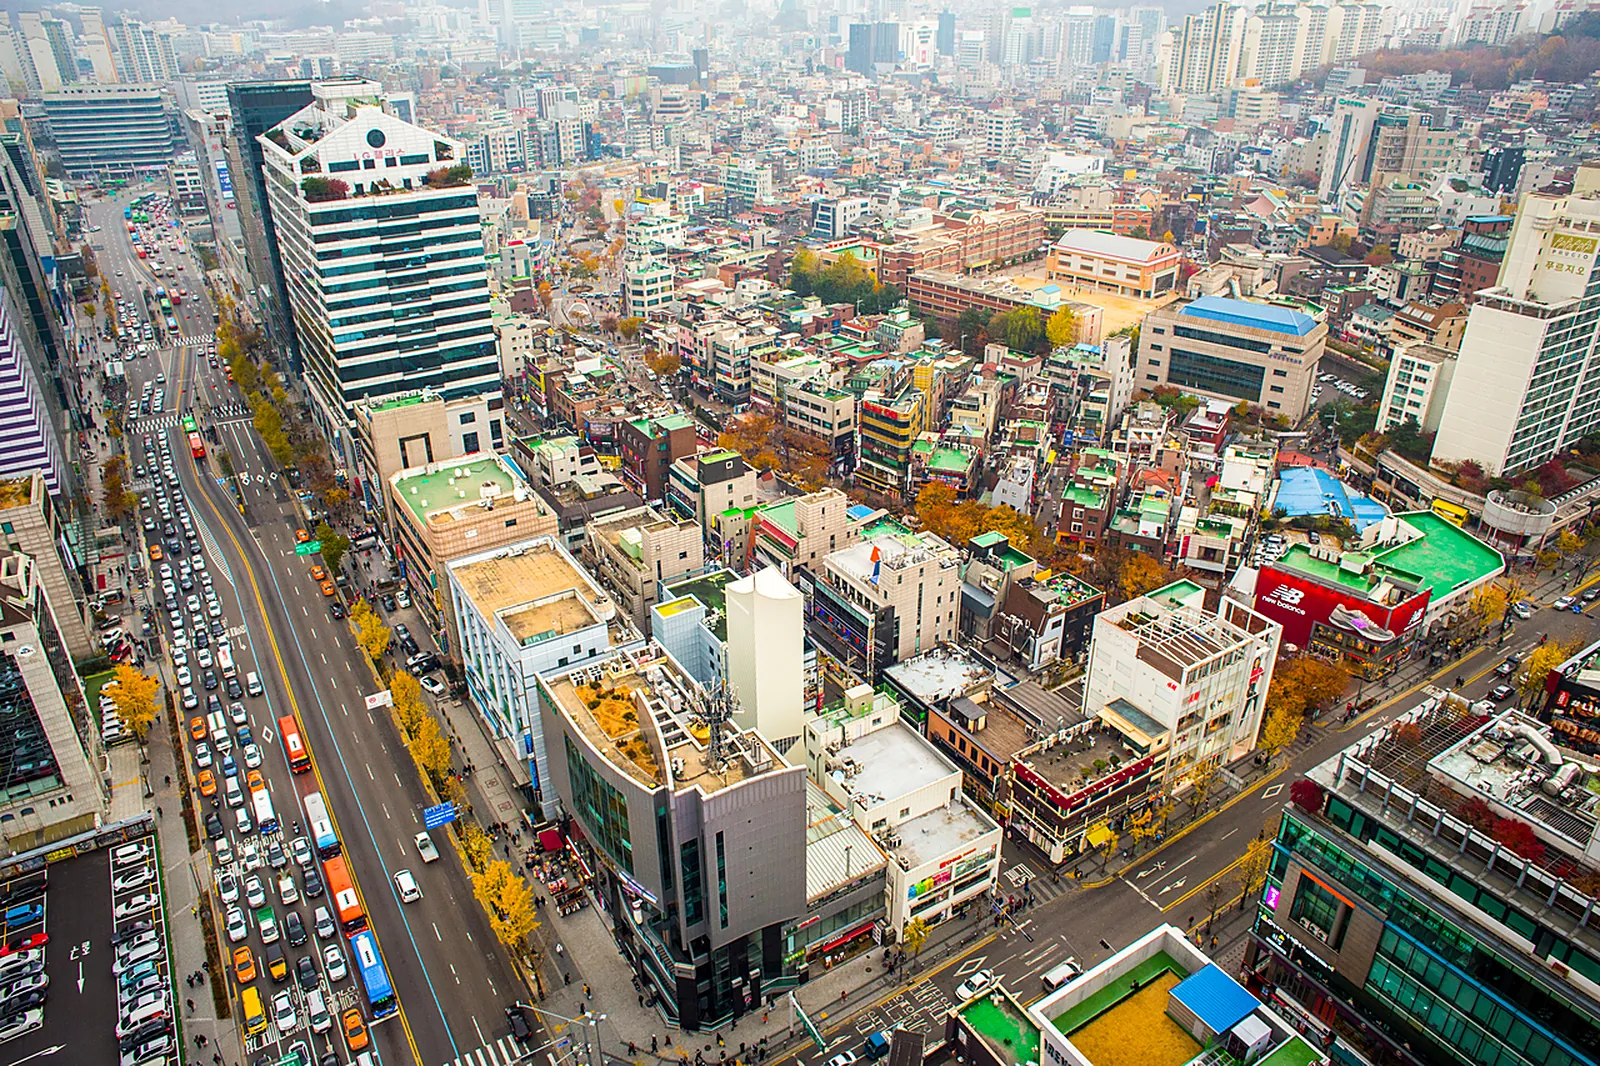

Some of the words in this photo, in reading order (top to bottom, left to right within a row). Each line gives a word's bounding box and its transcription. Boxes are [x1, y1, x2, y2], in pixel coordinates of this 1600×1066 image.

[1545, 260, 1585, 276] 푸르지오
[1262, 595, 1277, 605] new
[1276, 599, 1306, 616] balance
